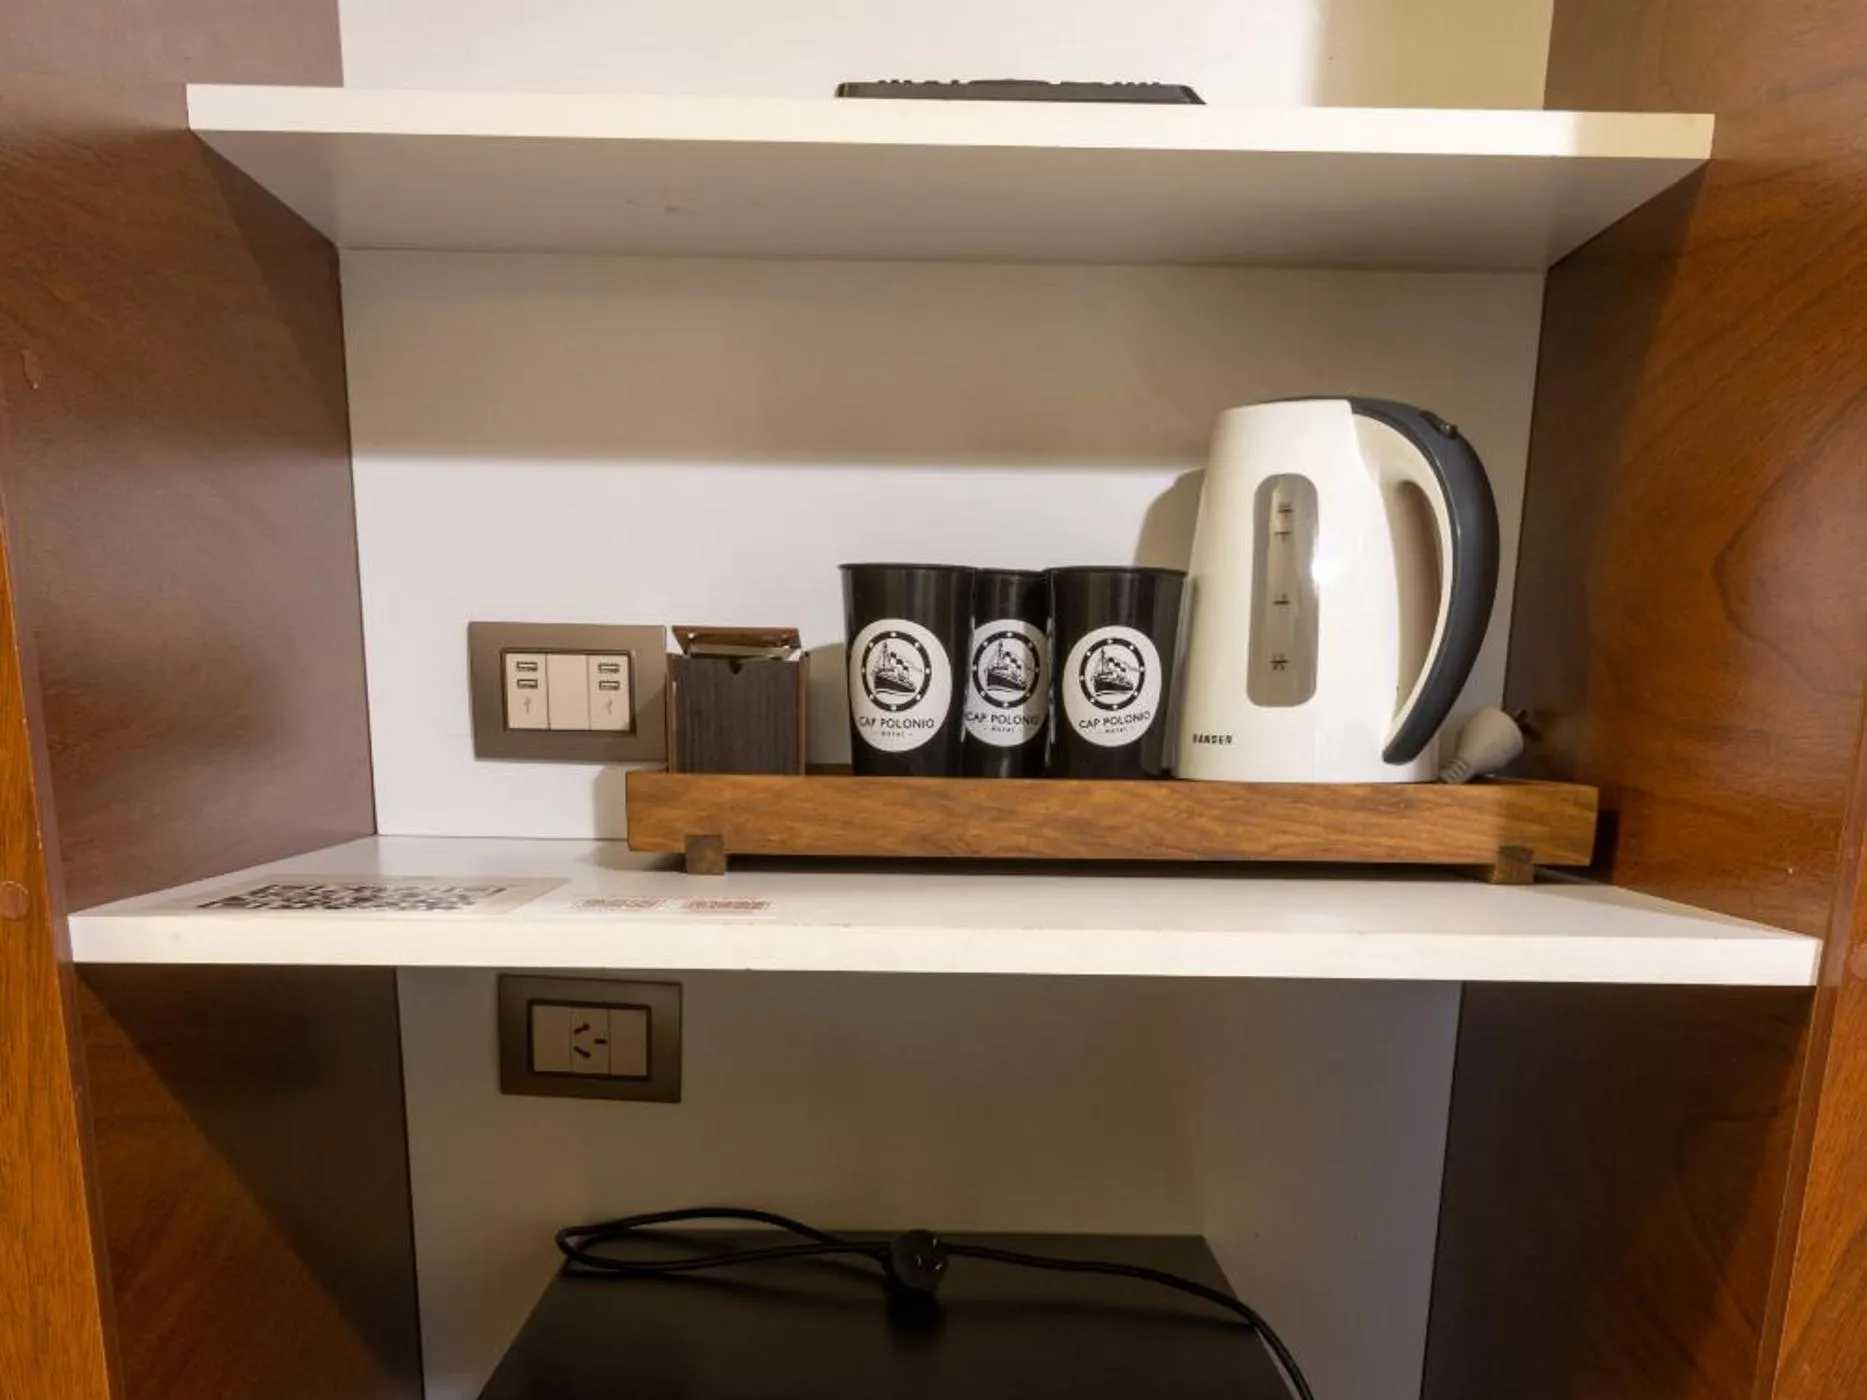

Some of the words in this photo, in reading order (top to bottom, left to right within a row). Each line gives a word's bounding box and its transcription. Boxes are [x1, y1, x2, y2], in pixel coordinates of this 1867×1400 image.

[880, 718, 934, 729] POLONIO
[1079, 718, 1100, 729] CAP
[1102, 710, 1150, 726] POLONIO
